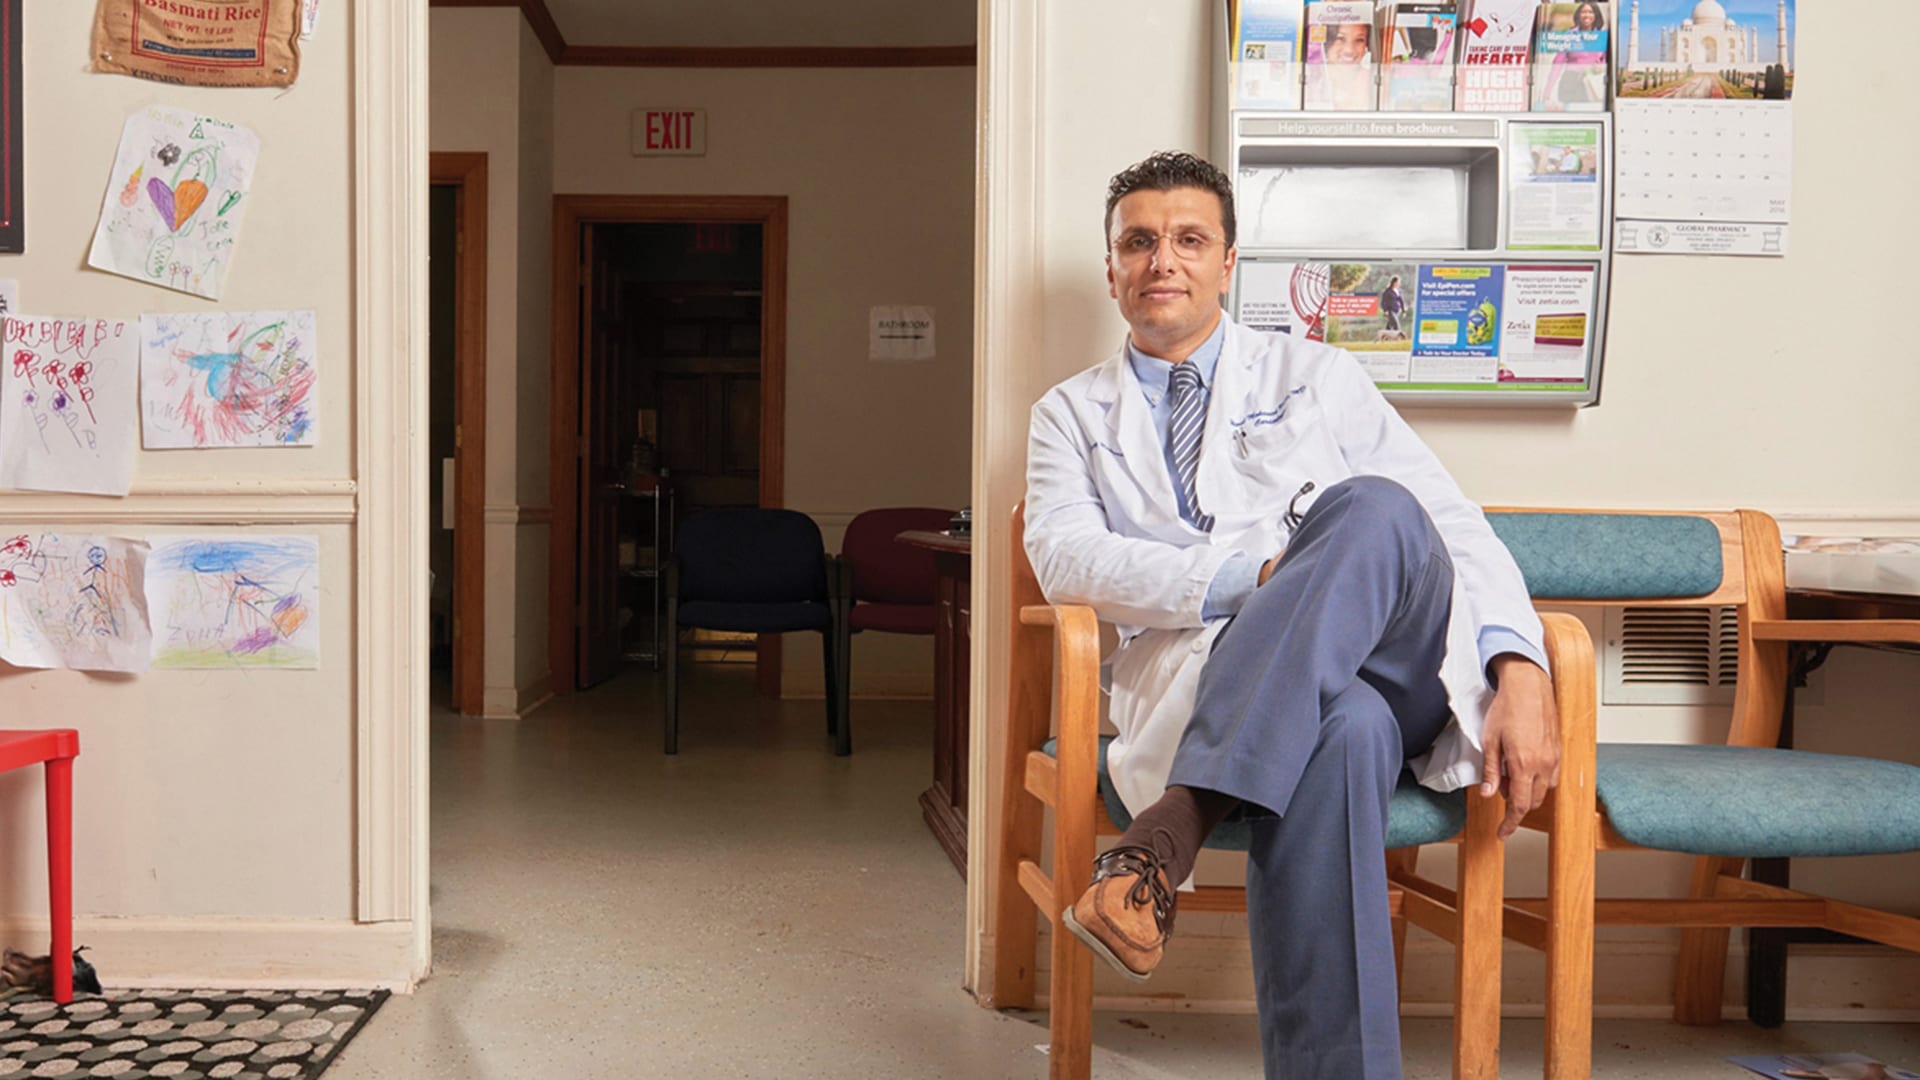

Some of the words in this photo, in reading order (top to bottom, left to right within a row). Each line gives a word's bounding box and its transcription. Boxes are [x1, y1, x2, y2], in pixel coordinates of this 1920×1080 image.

[225, 6, 261, 21] Rice
[163, 18, 183, 30] NET
[1547, 32, 1581, 42] Managing
[1582, 33, 1599, 41] Your
[1547, 42, 1571, 51] Weight
[1467, 53, 1525, 65] HEART
[1466, 69, 1523, 88] HIGH
[1465, 89, 1522, 104] BLOOD
[646, 111, 695, 150] EXIT
[1278, 122, 1305, 135] Help
[1308, 122, 1353, 135] yourself
[1356, 123, 1368, 134] to
[1370, 122, 1394, 134] free
[1396, 122, 1458, 134] brochures.
[1437, 282, 1476, 290] EpiPen.com
[878, 320, 930, 329] BATHROOM
[1507, 319, 1531, 330] Zetia
